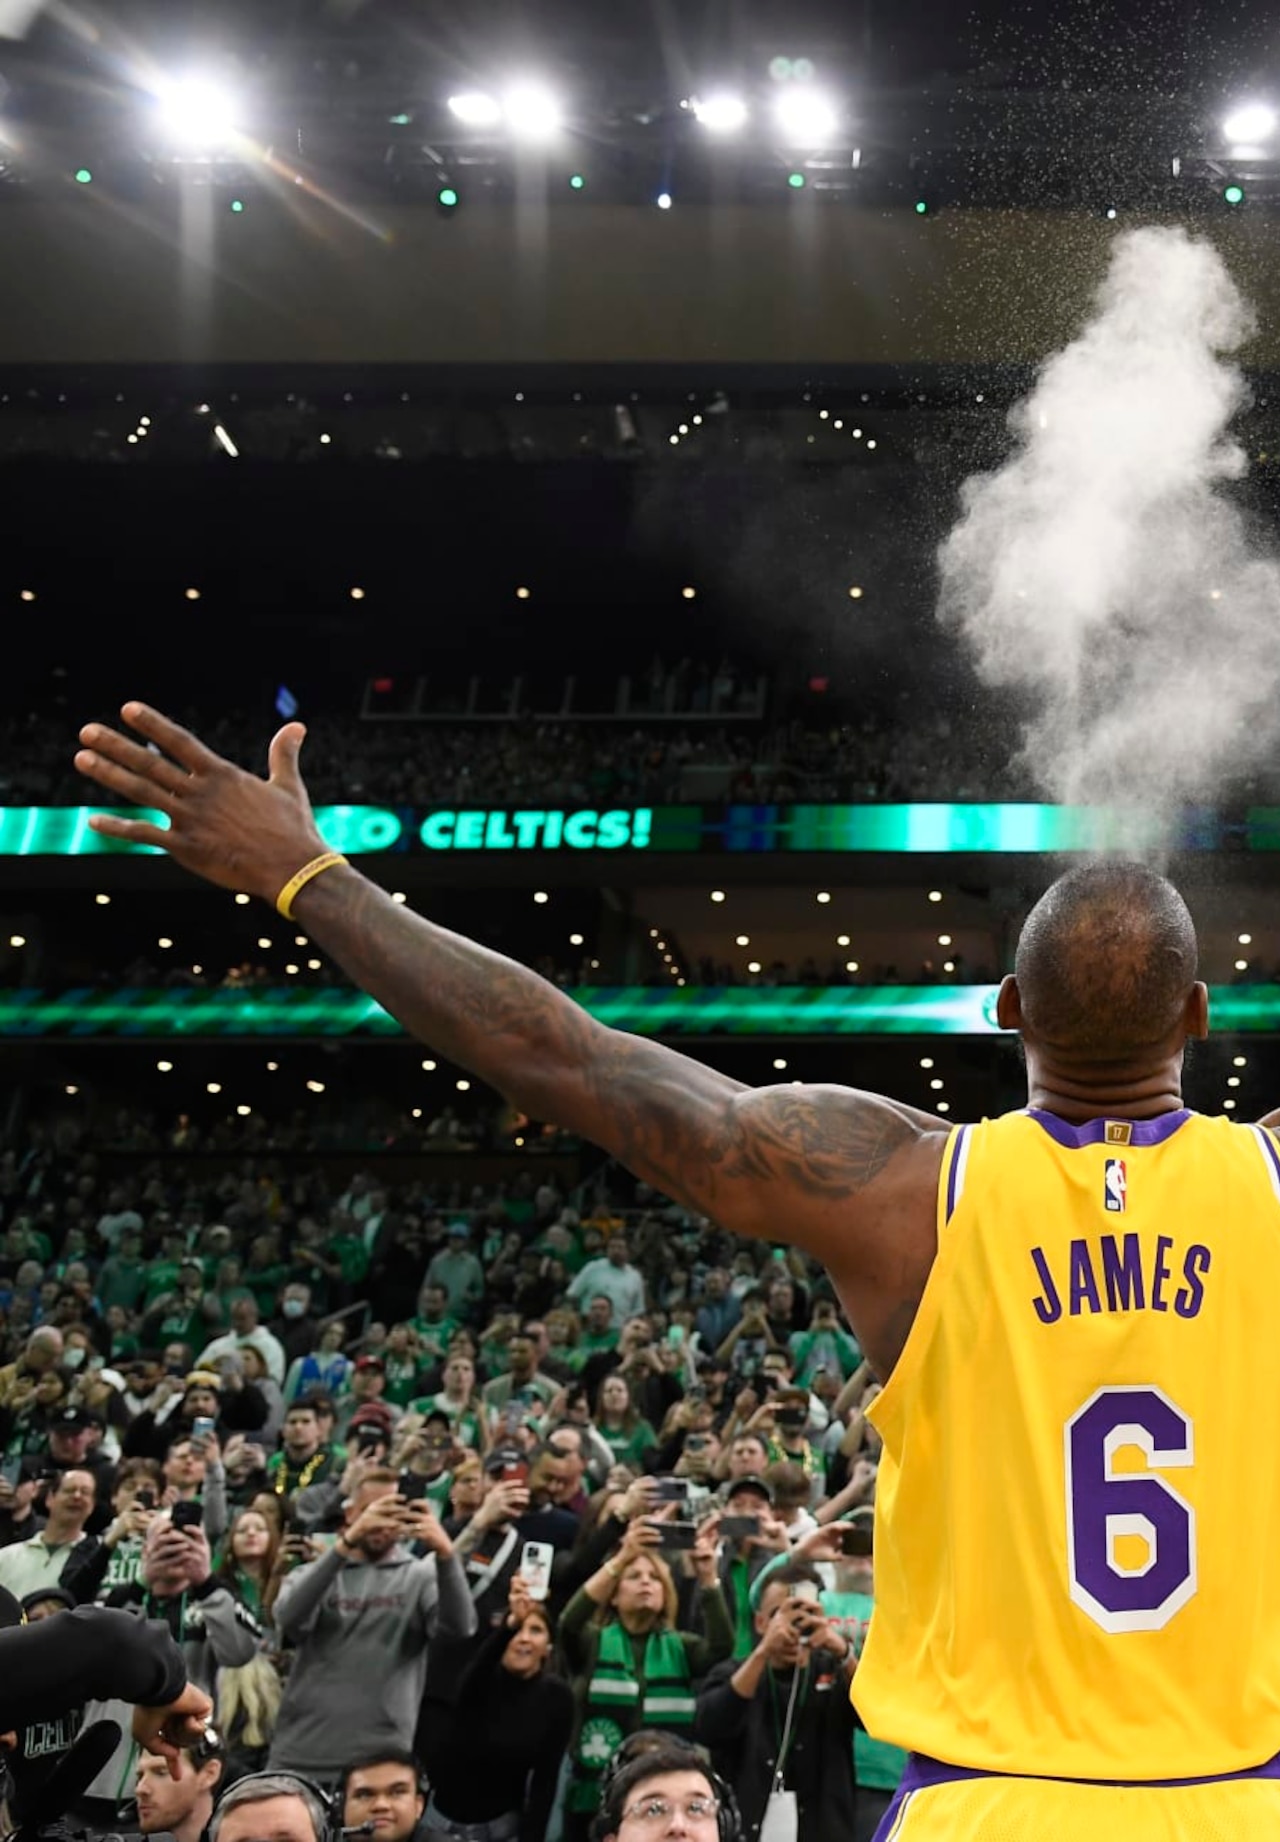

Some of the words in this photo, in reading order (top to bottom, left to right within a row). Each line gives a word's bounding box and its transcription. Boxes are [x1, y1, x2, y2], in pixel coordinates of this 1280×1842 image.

[420, 808, 652, 849] CELTICS!
[1030, 1232, 1211, 1324] JAMES
[1063, 1384, 1198, 1634] 6
